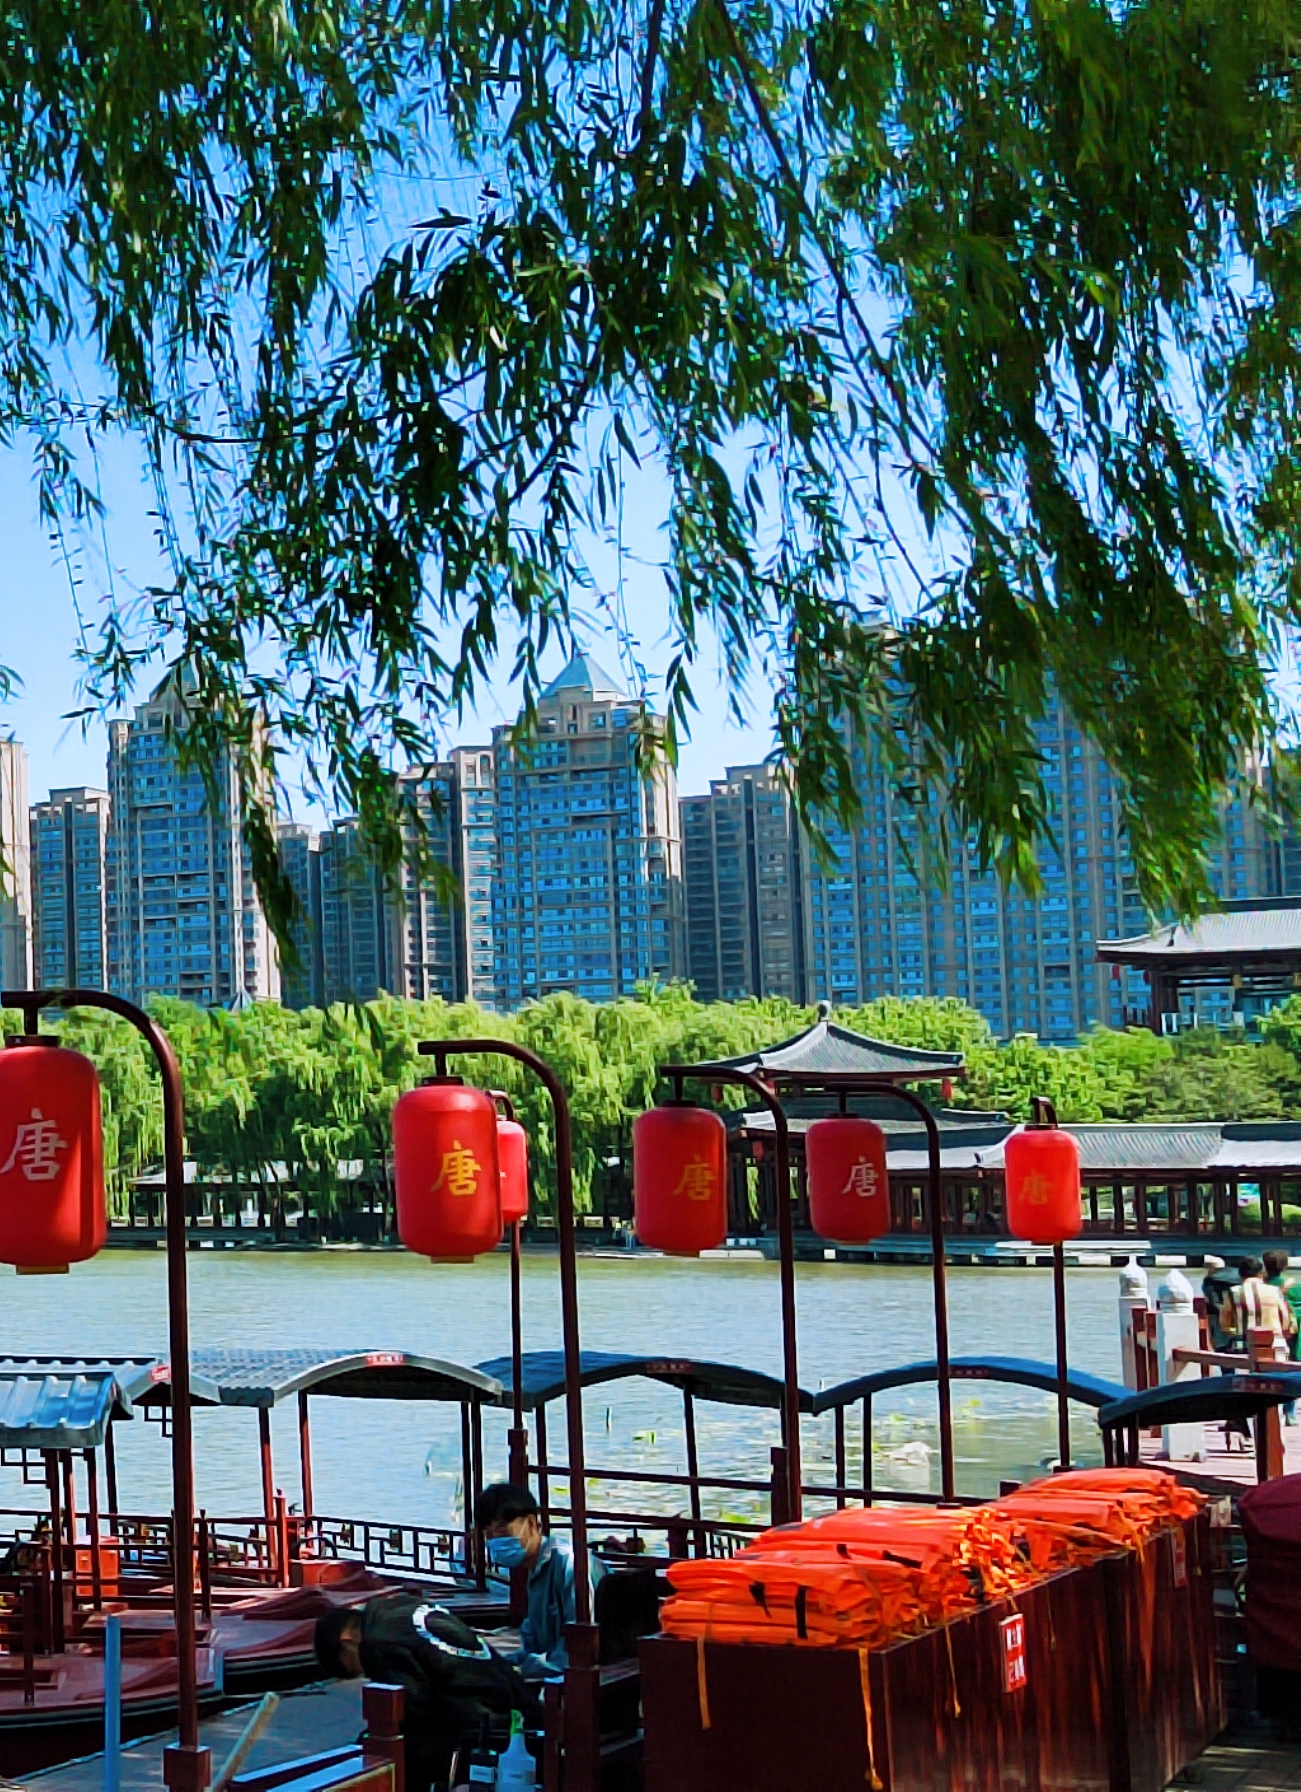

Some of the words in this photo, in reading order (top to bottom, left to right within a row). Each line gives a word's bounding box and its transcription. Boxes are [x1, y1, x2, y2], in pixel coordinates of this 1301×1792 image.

[0, 1107, 68, 1181] 唐
[429, 1139, 482, 1196] 唐
[672, 1153, 715, 1201] 唐
[840, 1155, 879, 1197] 唐
